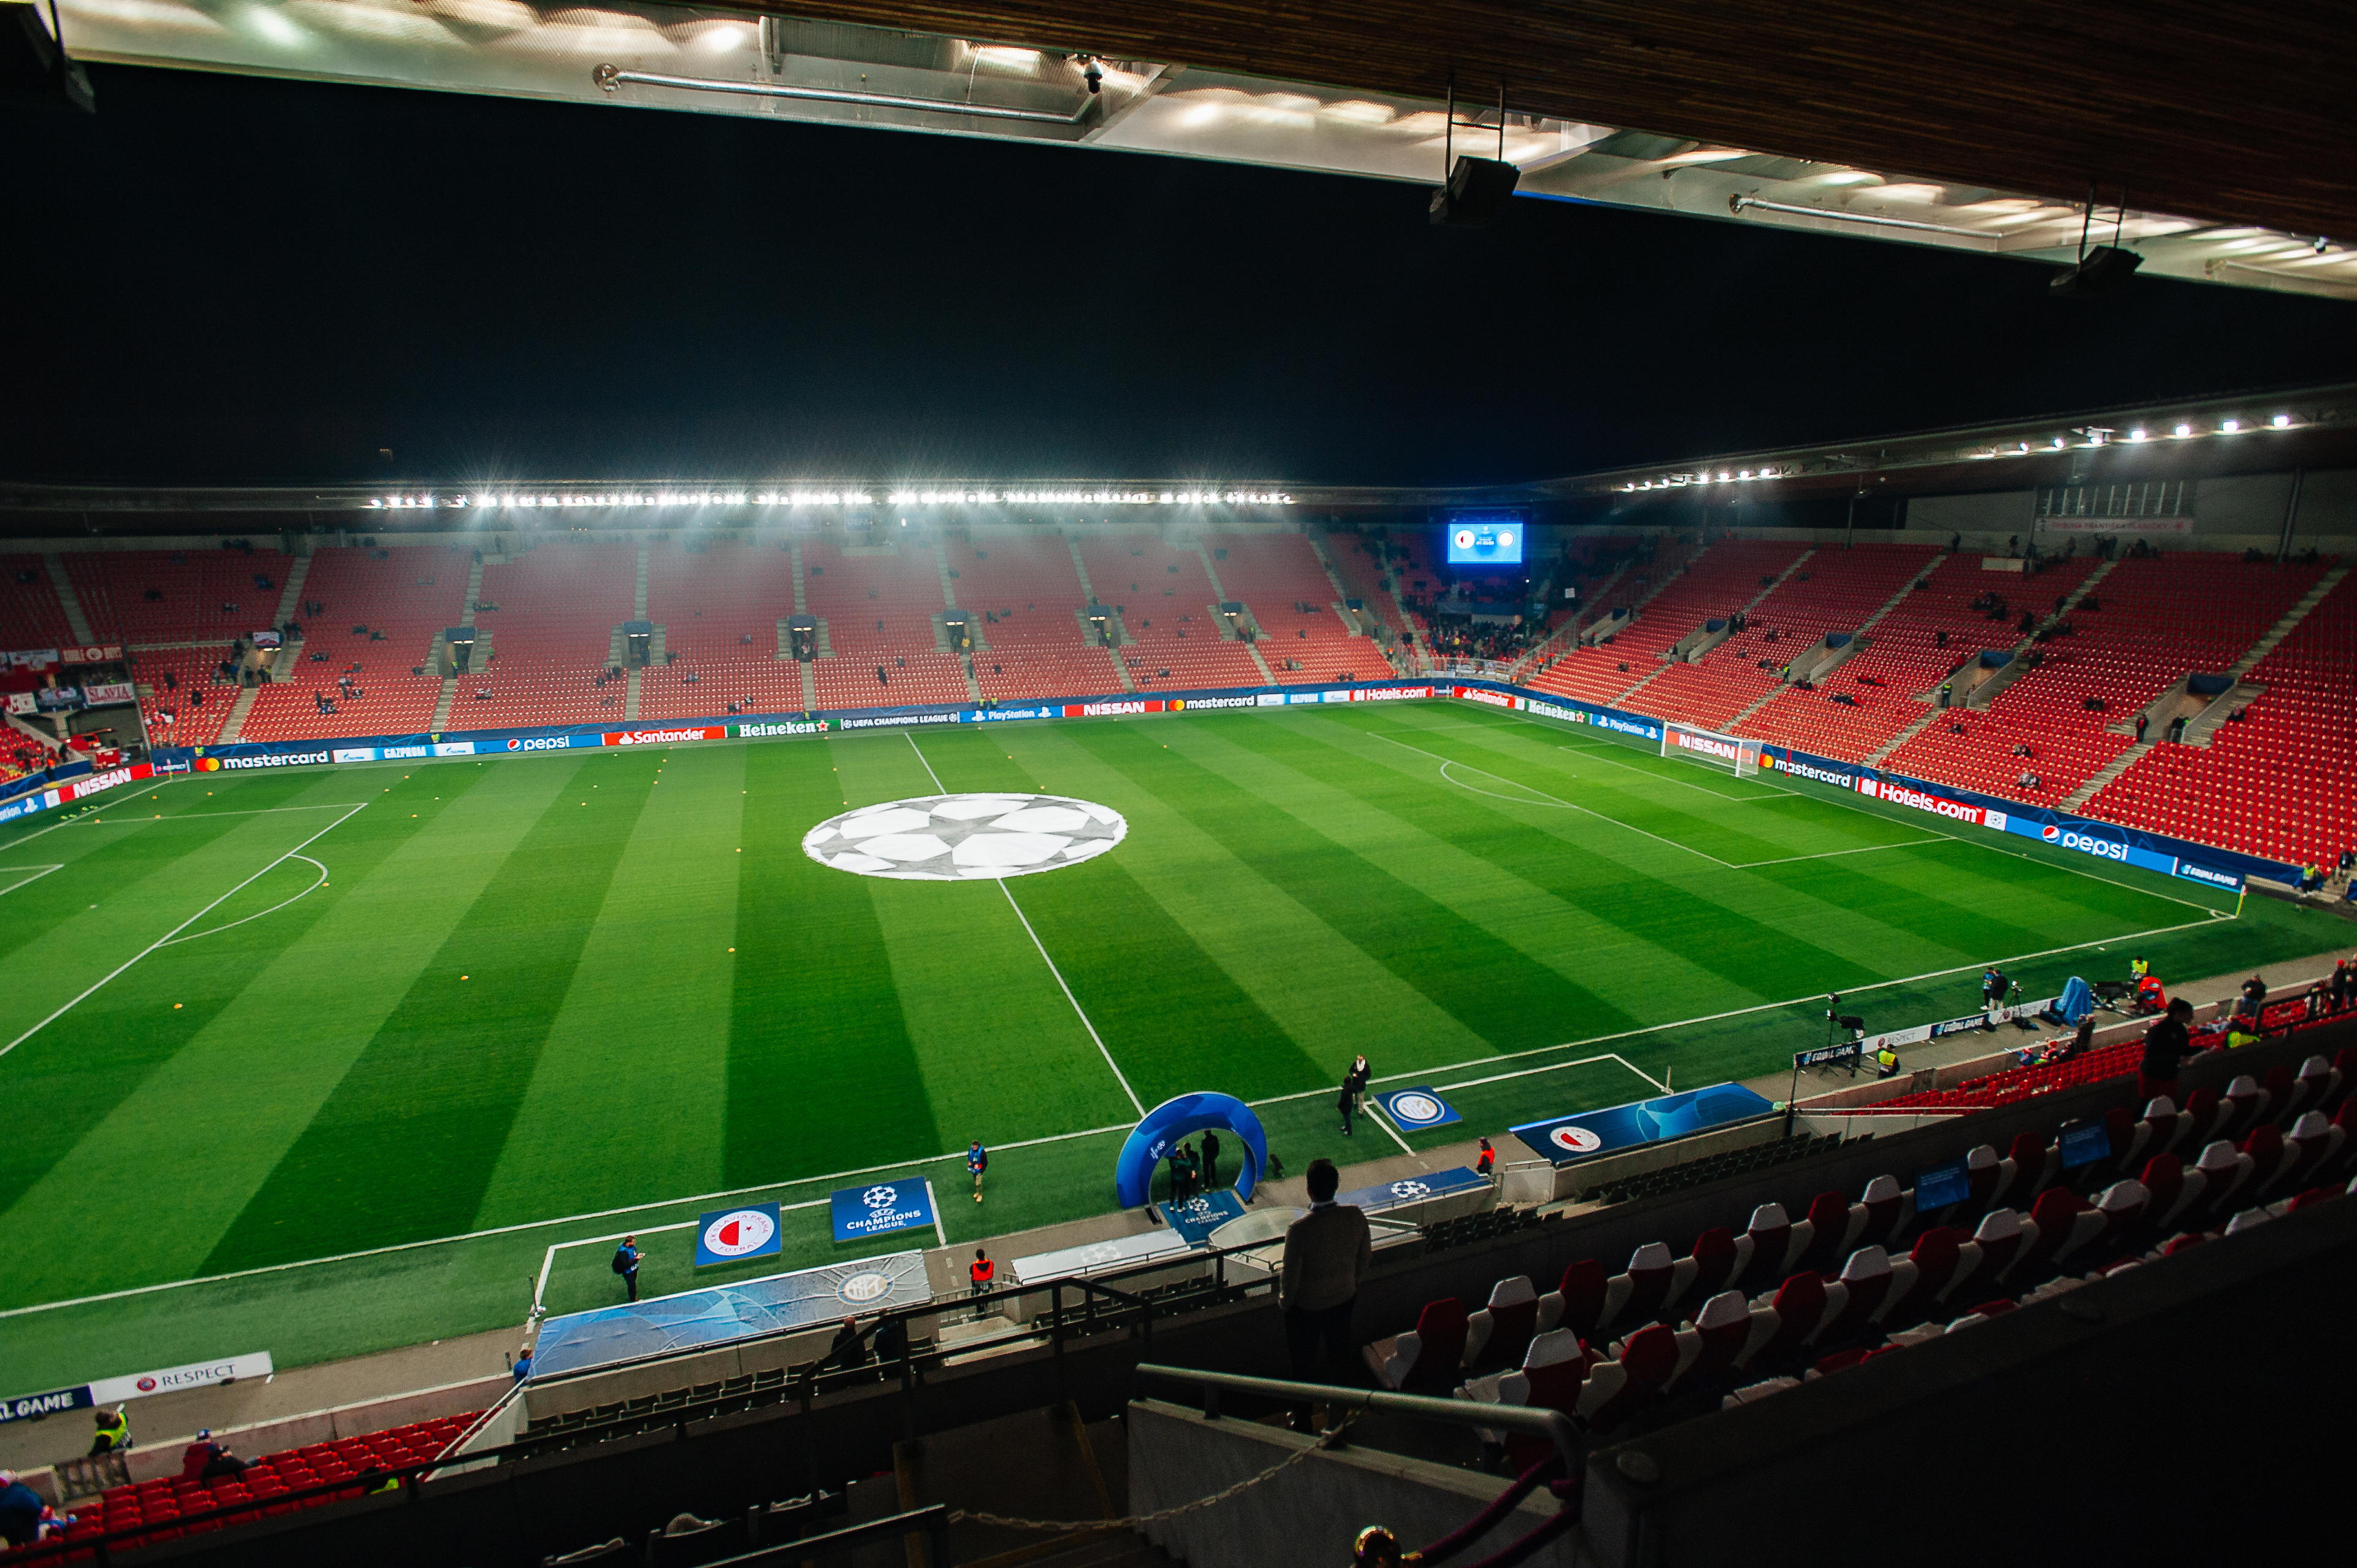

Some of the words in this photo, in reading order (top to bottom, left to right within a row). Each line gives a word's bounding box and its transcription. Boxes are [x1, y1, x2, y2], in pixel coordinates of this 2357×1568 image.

[1083, 702, 1145, 716] NISSAN
[1186, 695, 1255, 709] mastercard
[1528, 700, 1576, 722] Heineken
[853, 719, 873, 727] UEFA
[874, 716, 919, 726] CHAMPIONS
[919, 714, 948, 723] LEAGUE
[988, 709, 1035, 721] PlayStation
[633, 728, 705, 744] Santander
[739, 721, 816, 737] Heineken
[1610, 719, 1645, 735] PlayStation
[524, 735, 570, 751] pepsi
[1679, 734, 1736, 760] NISSAN
[223, 751, 329, 770] mastercard
[1775, 759, 1851, 788] mastercard
[72, 768, 132, 798] NISSAN
[1879, 783, 1978, 823] Hotels.com
[2062, 832, 2129, 861] pepsi
[713, 1215, 747, 1232] SLAVIA
[846, 1210, 921, 1229] CHAMPIONS
[719, 1242, 759, 1251] FOTBAL
[162, 1364, 237, 1387] RESPECT
[17, 1392, 74, 1417] GAME
